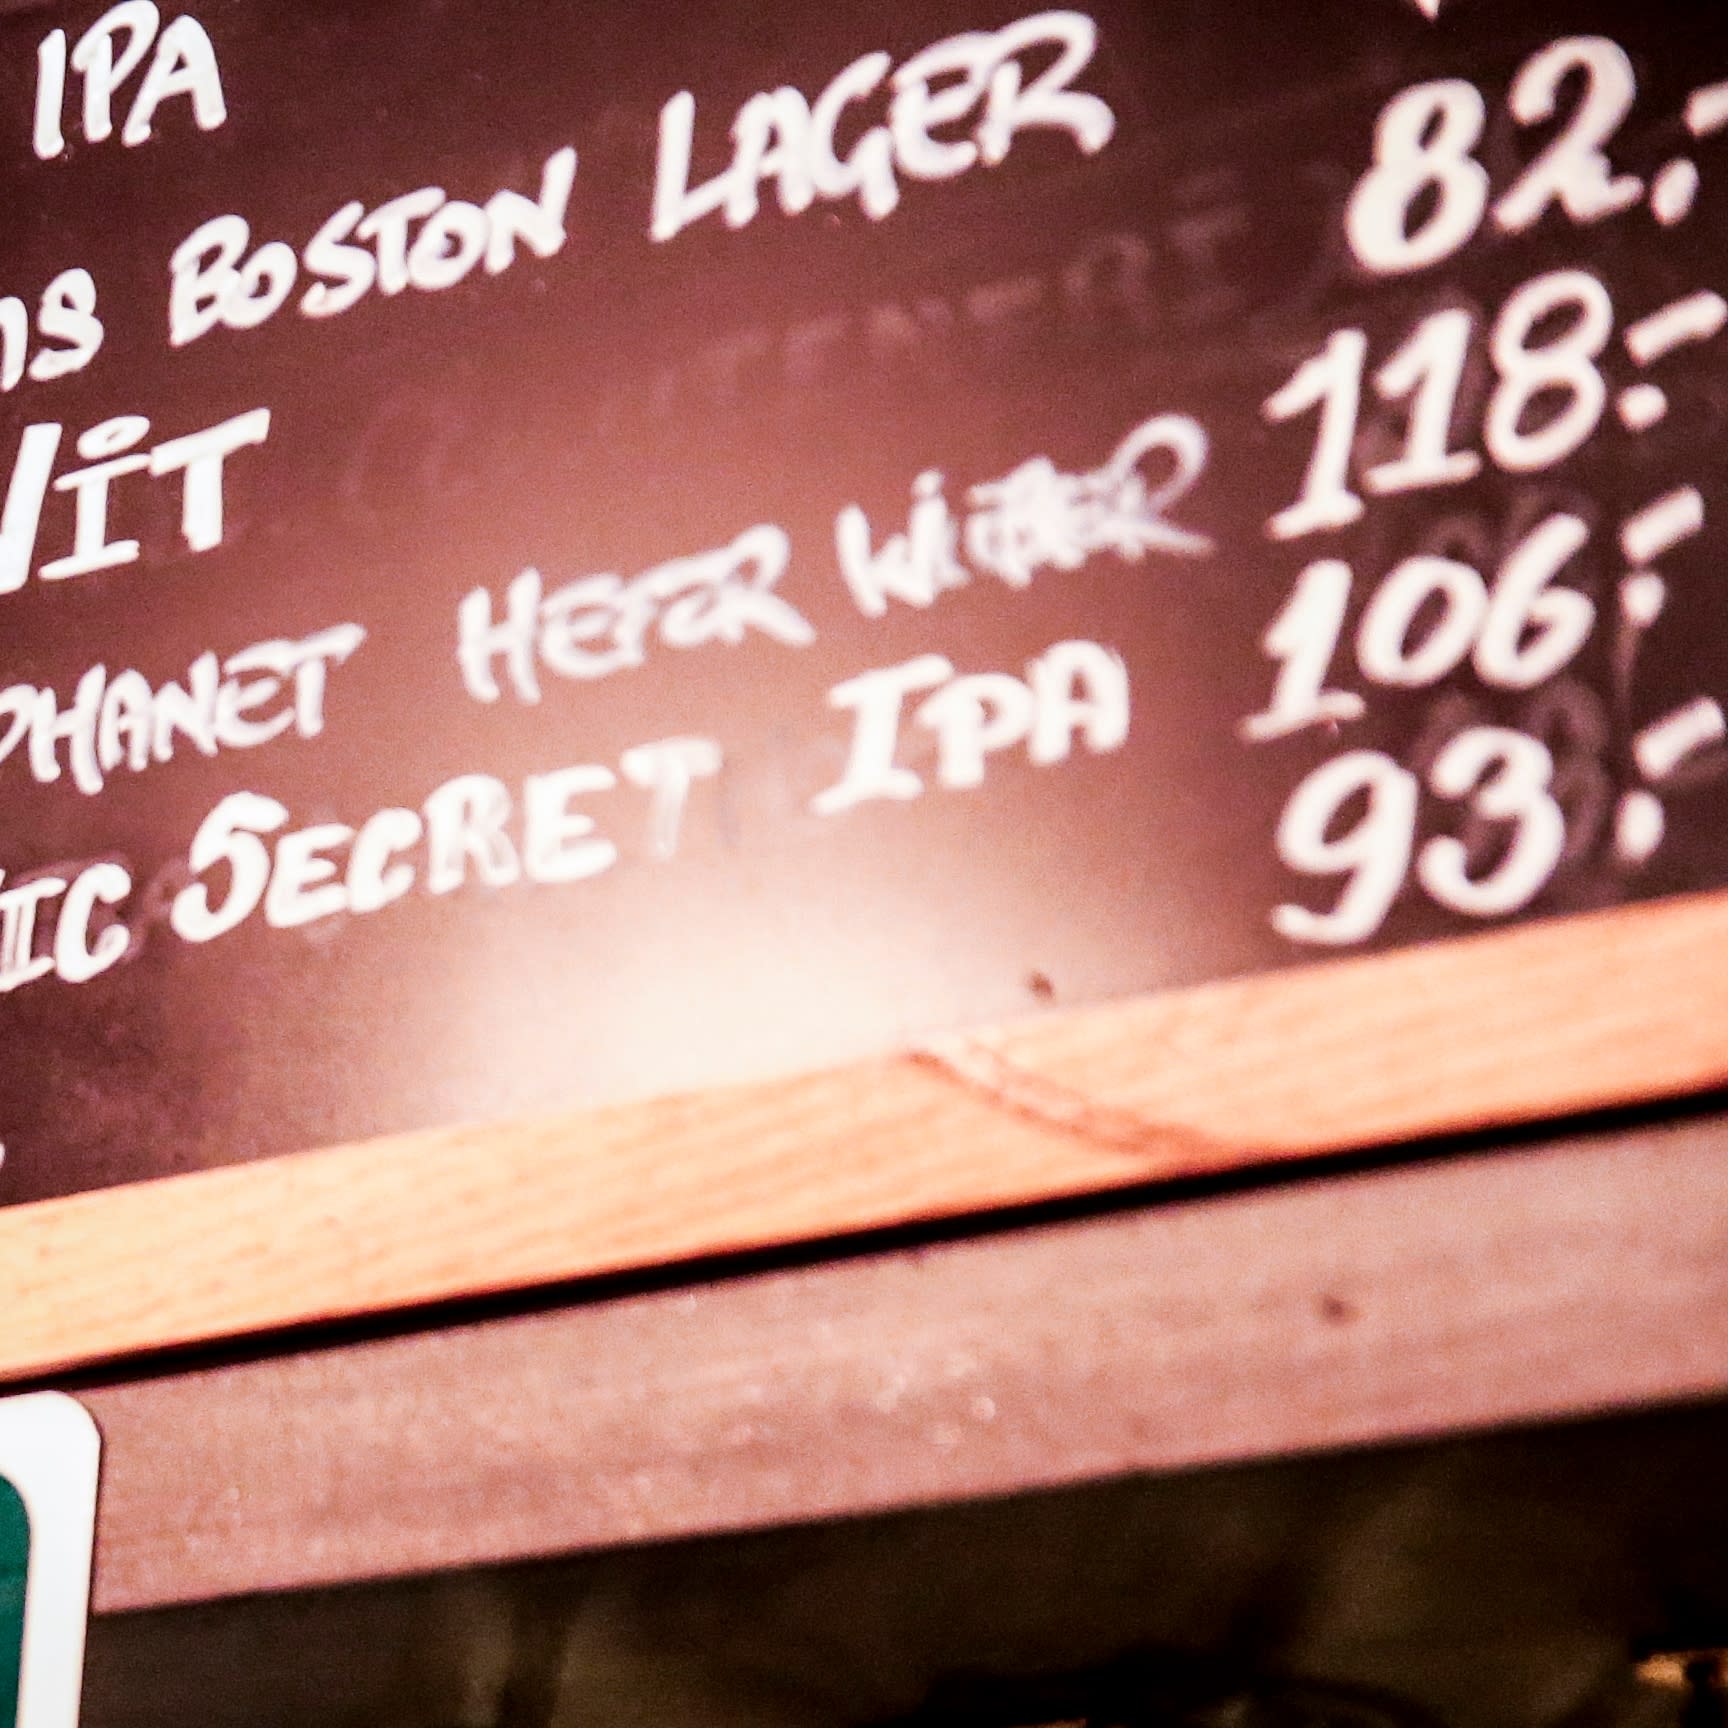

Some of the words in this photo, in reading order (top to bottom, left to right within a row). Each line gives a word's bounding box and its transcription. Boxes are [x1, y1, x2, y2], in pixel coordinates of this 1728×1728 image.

[33, 0, 227, 159] IPA
[168, 145, 578, 347] BOSTON
[648, 9, 1115, 244] LAGER
[170, 737, 721, 945] SECRET
[814, 638, 1131, 817] IPA
